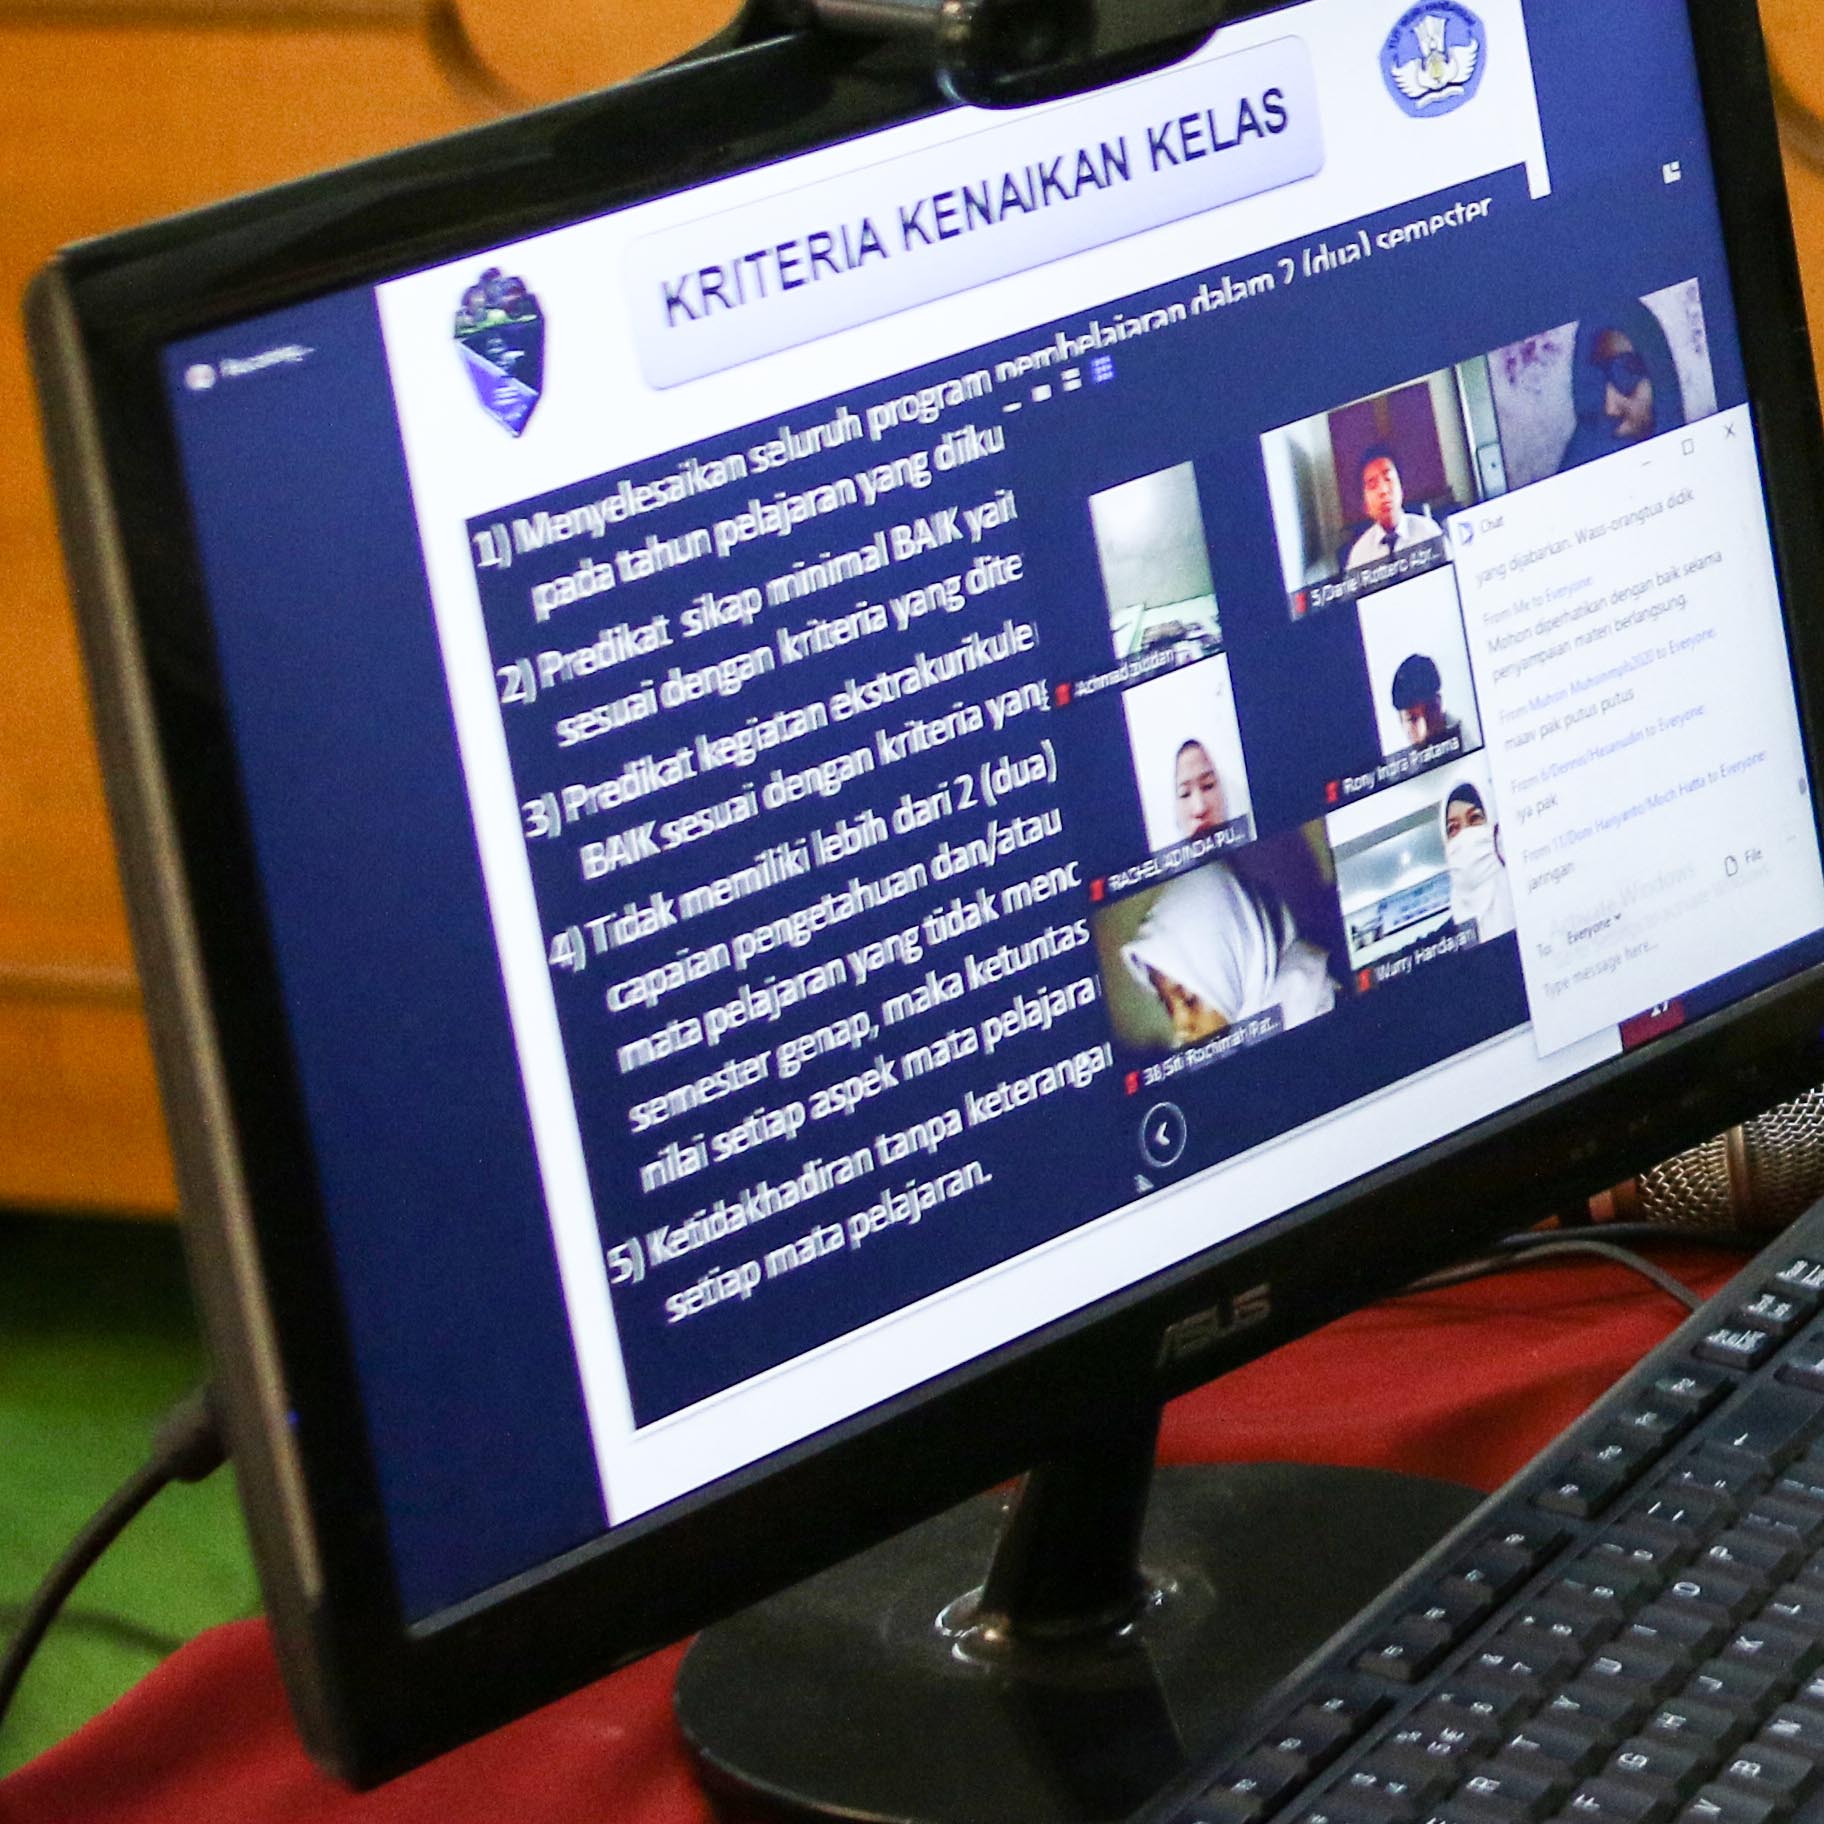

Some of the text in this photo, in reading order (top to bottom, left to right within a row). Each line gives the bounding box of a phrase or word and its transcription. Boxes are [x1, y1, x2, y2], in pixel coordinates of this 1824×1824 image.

[662, 88, 1288, 320] KRITERIA KENAIKAN KELAS
[473, 524, 512, 568] 1)
[512, 455, 747, 553] Menyelesaikan
[748, 406, 863, 473] seluruh
[866, 370, 992, 441] program
[532, 558, 615, 622] pada
[615, 529, 712, 582] tahun
[714, 474, 864, 557] pelajaran
[858, 452, 931, 505] yang
[497, 659, 536, 703] 2)
[537, 615, 673, 688] Predikat
[681, 588, 762, 637] sikap
[766, 531, 889, 605] minimal
[890, 507, 963, 560] BAIK
[556, 555, 1023, 747] sesuai dengan kriteria yang dite
[1611, 579, 1653, 605] dengan
[522, 620, 1043, 837] 3) Predikat kegiatan ekstrakurikule
[580, 821, 661, 880] BAIK
[660, 782, 758, 850] sesuai
[762, 748, 874, 809] dengan
[876, 702, 983, 765] kriteria
[1410, 737, 1459, 772] Pratama
[1536, 796, 1558, 815] pak
[1540, 720, 1561, 739] pak
[1564, 704, 1598, 729] putus
[1601, 689, 1634, 715] putus
[549, 739, 1056, 972] 4) Tidak memiliki lebih dari 2 (dua)
[607, 808, 1062, 1012] capaian pengetahuan dan/atau
[618, 1018, 703, 1073] mata
[704, 959, 846, 1046] pelajaran
[847, 926, 923, 985] yang
[922, 888, 999, 945] tidak
[629, 919, 1089, 1132] semester genap, maka ketuntas
[641, 978, 1100, 1192] nilai setiap aspek mata pelajara
[607, 1237, 645, 1283] 5)
[647, 1148, 874, 1266] Ketidakhadiran
[875, 1109, 963, 1165] tanpa
[666, 1161, 992, 1323] setiap mata pelajaran.
